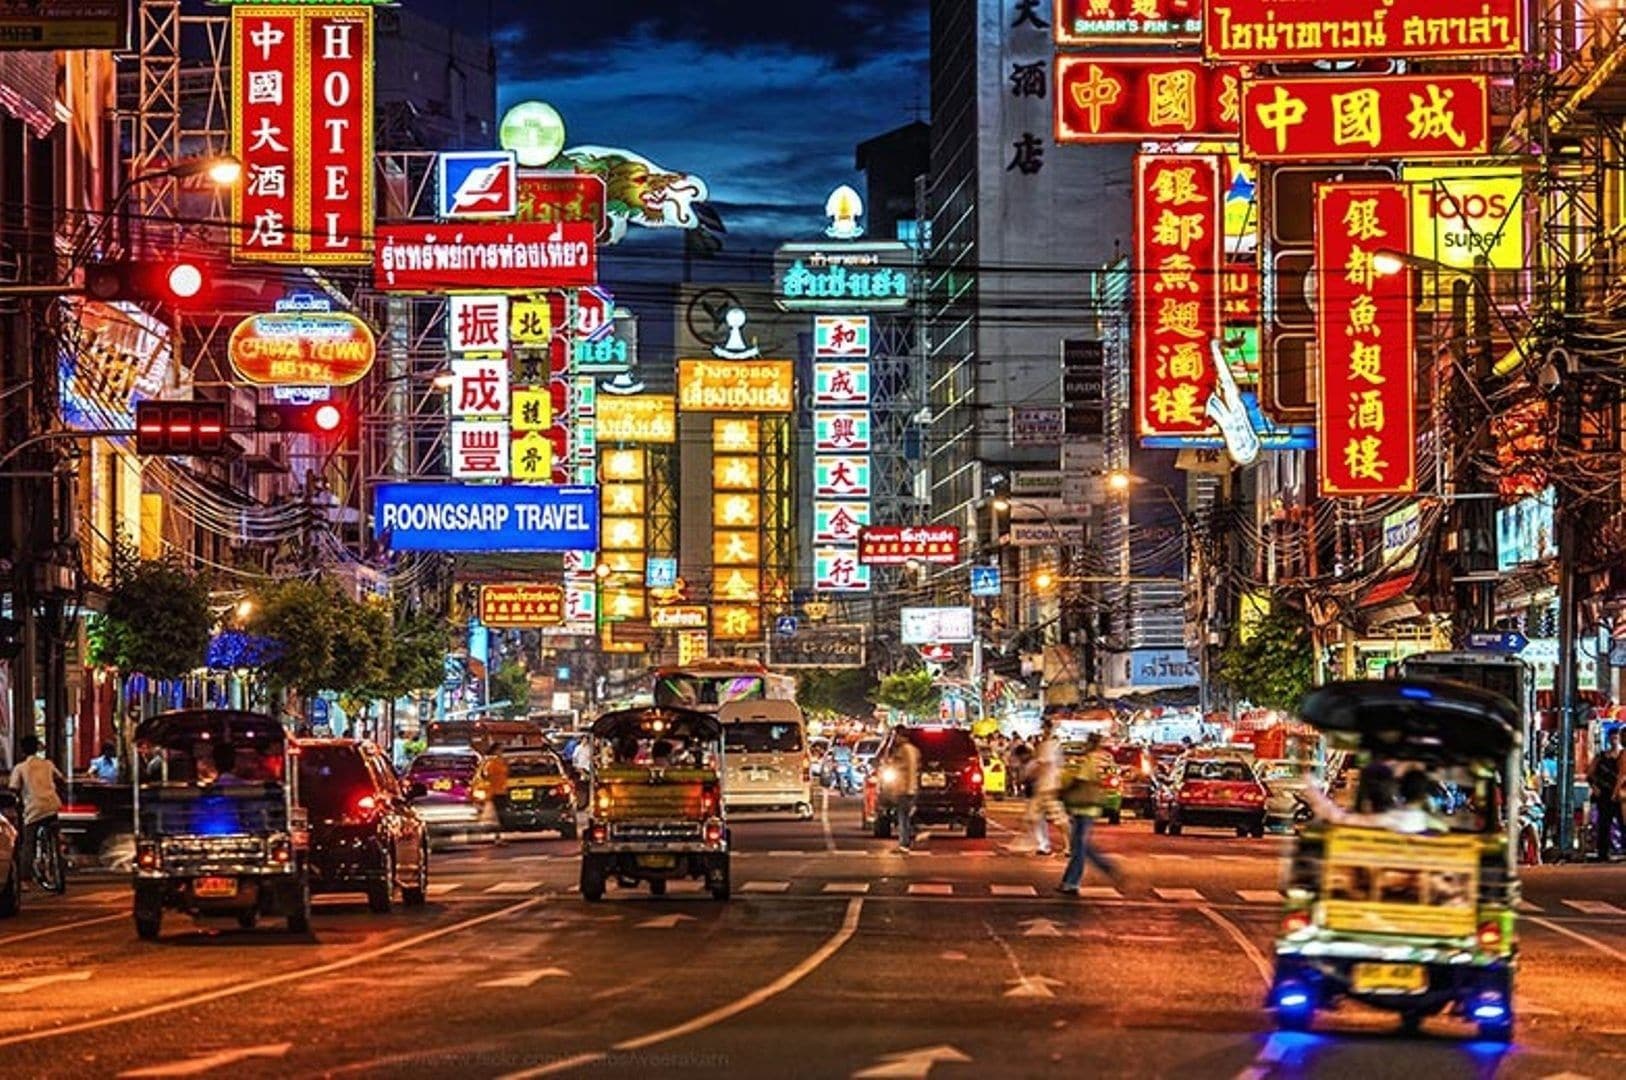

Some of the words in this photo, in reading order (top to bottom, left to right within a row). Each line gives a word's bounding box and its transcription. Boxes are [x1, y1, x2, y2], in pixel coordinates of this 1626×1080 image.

[1074, 17, 1138, 33] SHARK'S
[1402, 4, 1511, 46] สกาล่า
[247, 20, 289, 249] 中國大酒店
[321, 24, 353, 249] HOTEL
[1256, 84, 1467, 152] 中國城
[1418, 187, 1507, 230] Tops
[1444, 231, 1506, 253] super
[1343, 198, 1390, 483] 銀都魚翅酒樓
[457, 303, 502, 474] 振成豐
[829, 324, 858, 584] 和成興大金行
[383, 503, 510, 531] ROONGSARP
[514, 503, 591, 531] TRAVEL
